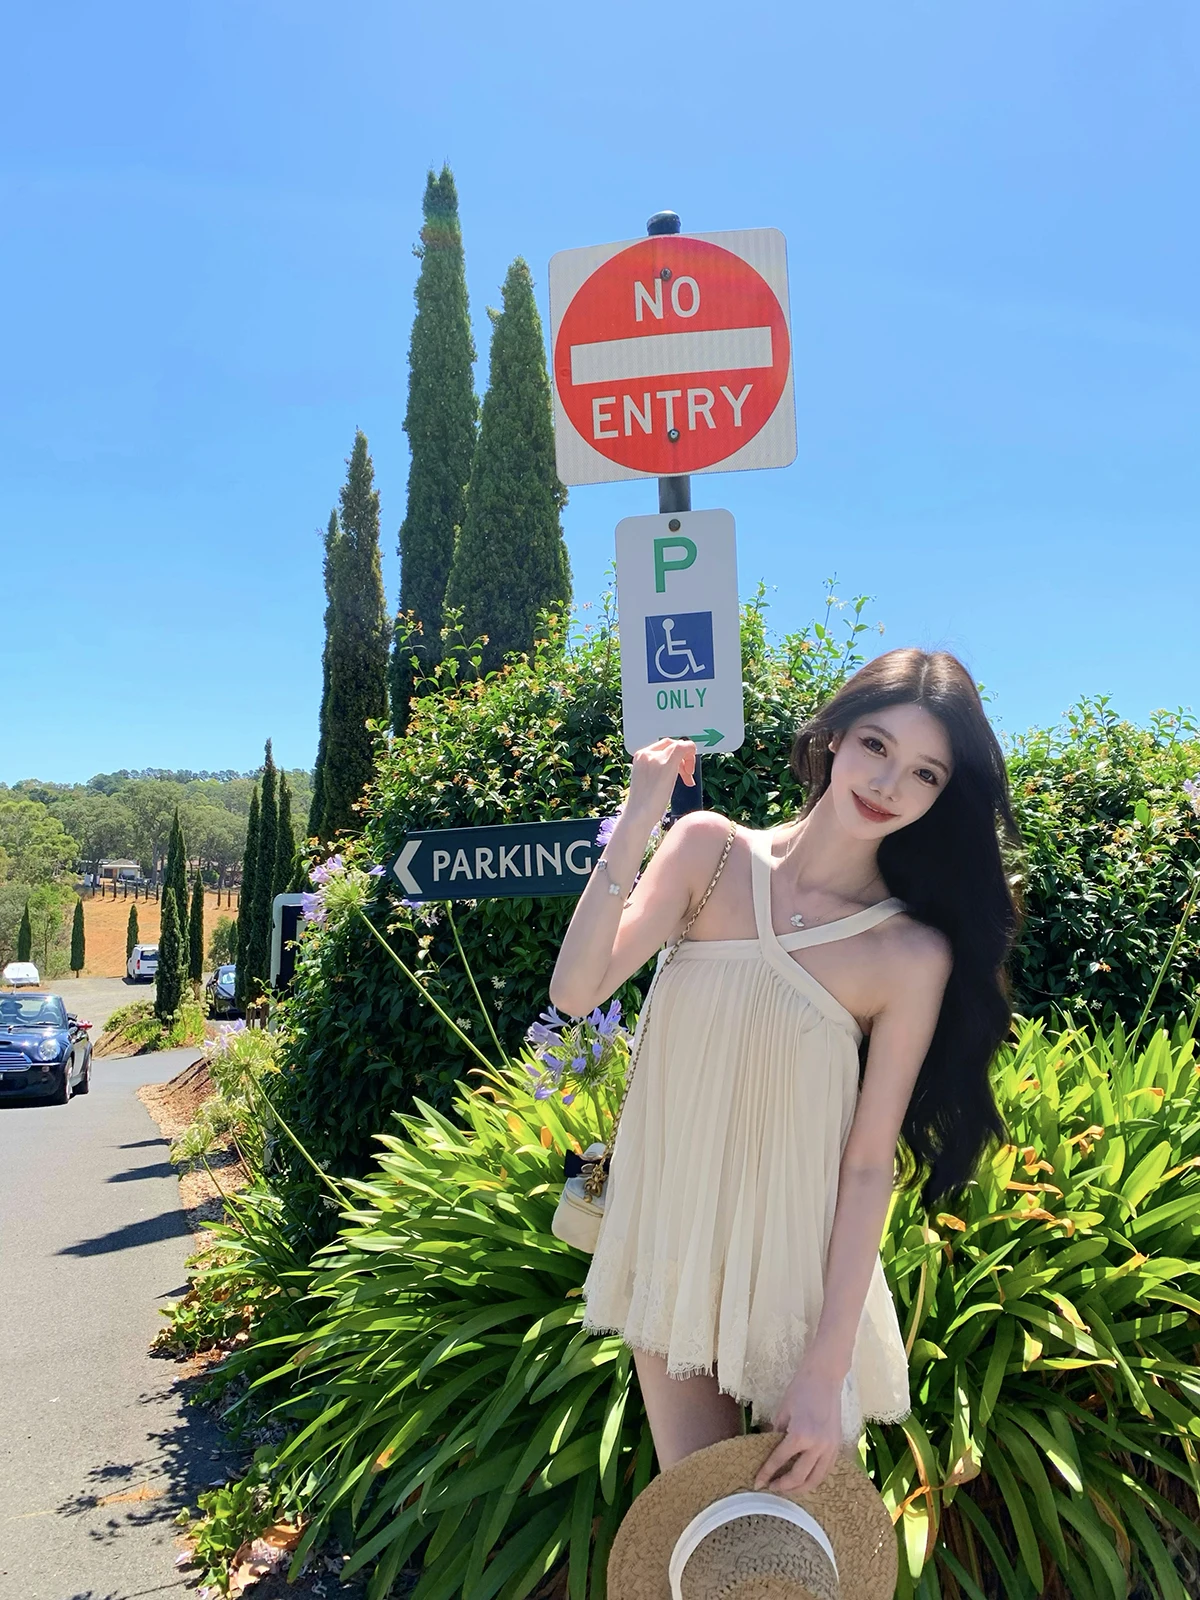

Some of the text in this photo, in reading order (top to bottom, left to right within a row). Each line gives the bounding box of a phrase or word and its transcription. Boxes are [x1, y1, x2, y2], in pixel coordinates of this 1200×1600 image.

[634, 276, 701, 322] NO
[592, 384, 753, 440] ENTRY
[654, 536, 697, 593] P
[656, 687, 707, 710] ONLY
[433, 839, 592, 882] PARKING
